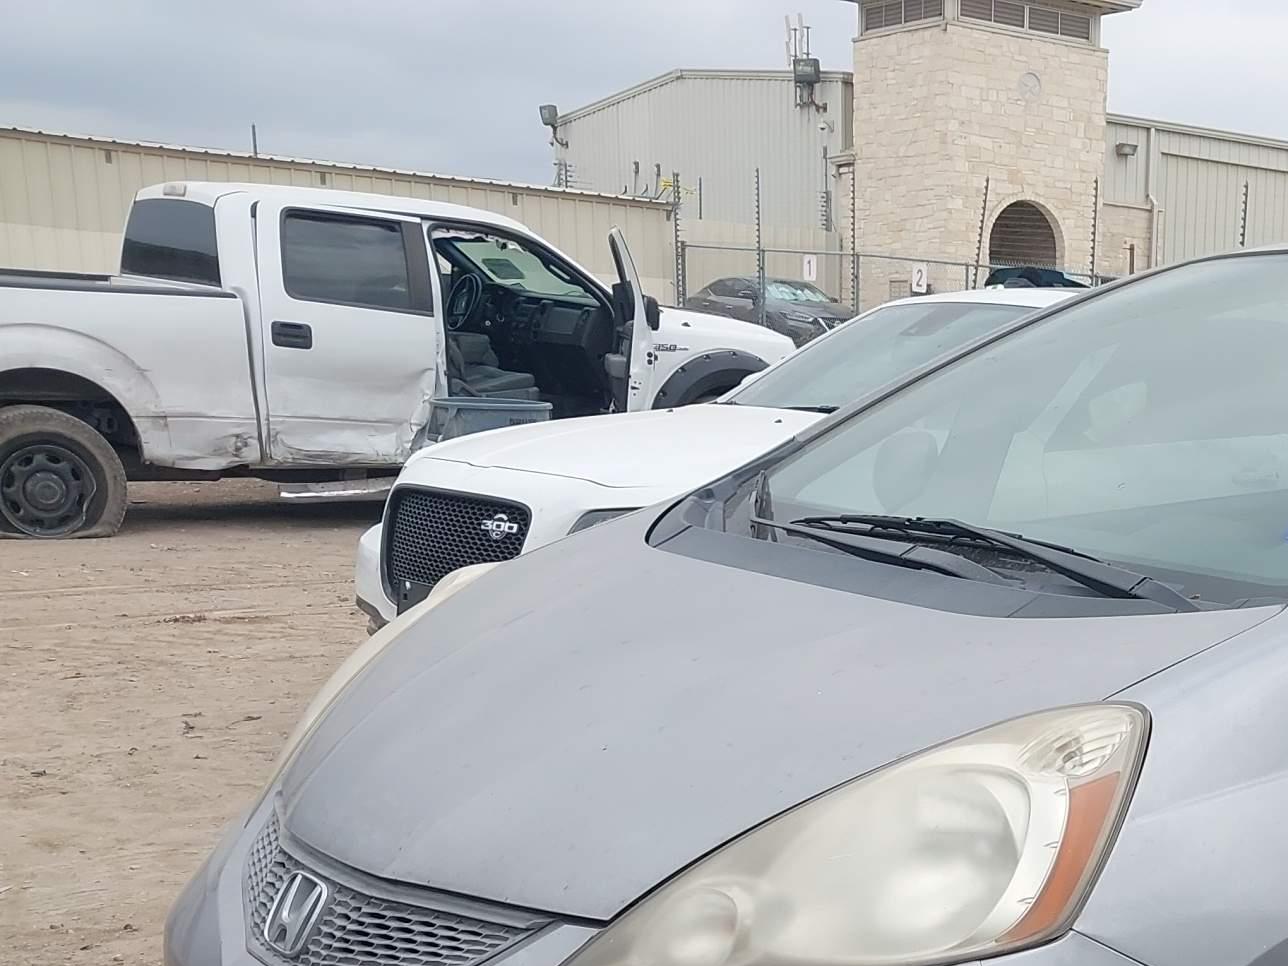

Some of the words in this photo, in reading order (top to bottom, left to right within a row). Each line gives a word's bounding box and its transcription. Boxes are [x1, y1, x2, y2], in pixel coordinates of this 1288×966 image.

[806, 259, 812, 278] 1
[915, 268, 924, 288] 2
[480, 519, 519, 534] 300
